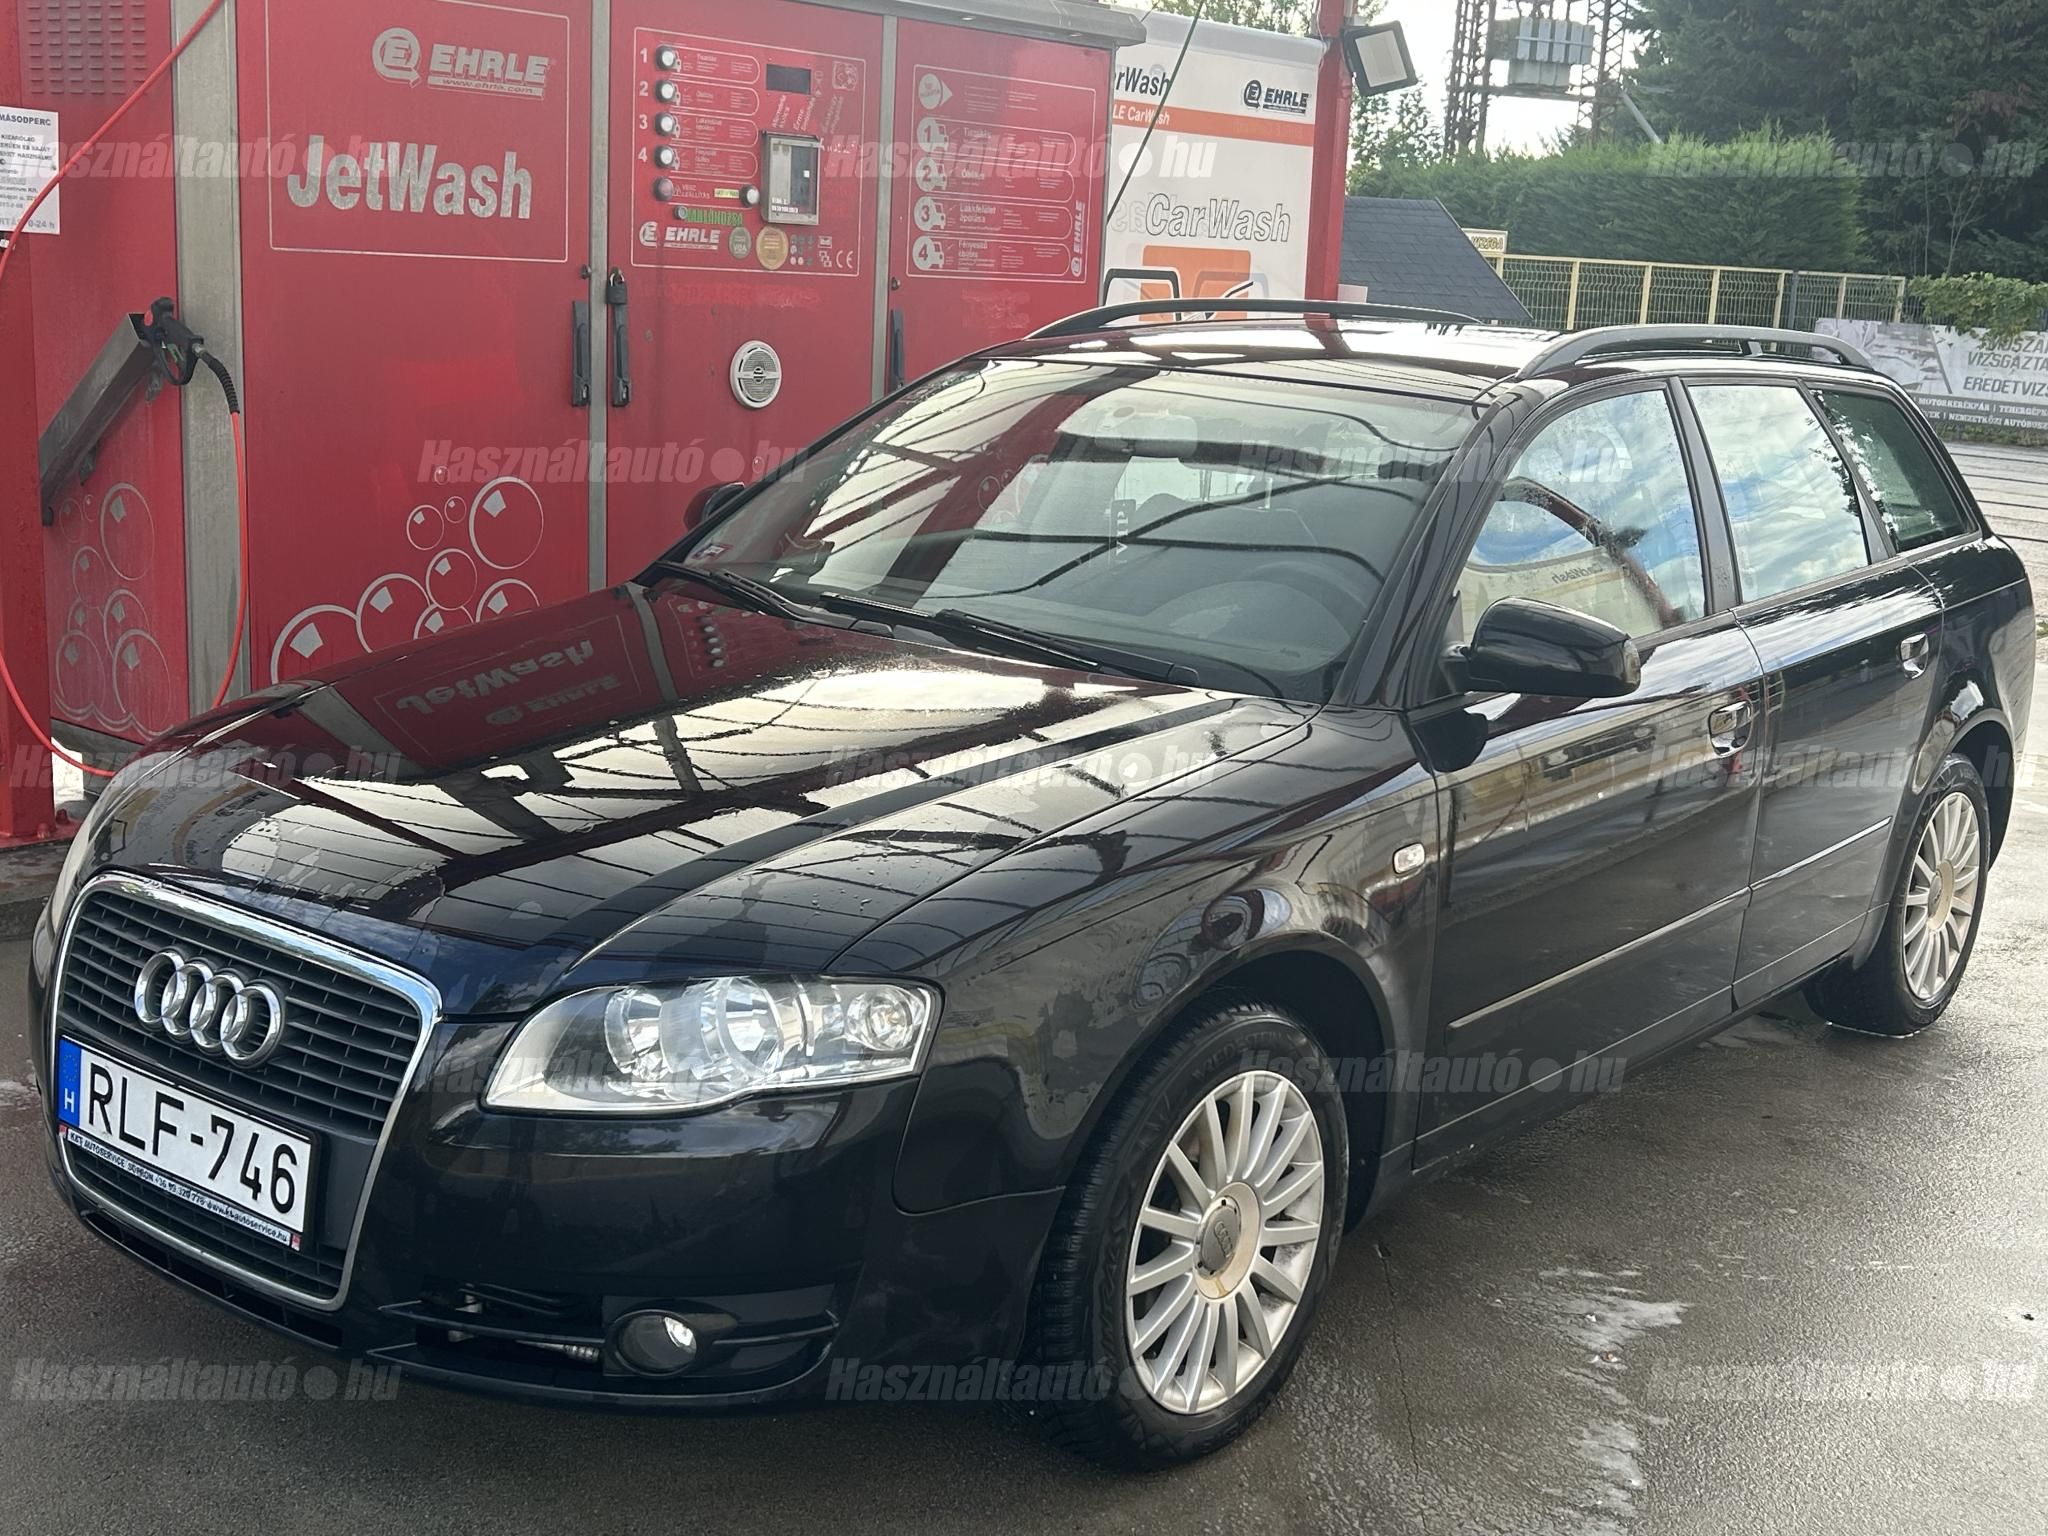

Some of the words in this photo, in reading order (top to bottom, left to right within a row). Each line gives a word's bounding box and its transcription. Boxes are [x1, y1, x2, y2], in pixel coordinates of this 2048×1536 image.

[429, 43, 548, 84] EHRLE
[640, 48, 648, 63] 1
[640, 81, 648, 96] 2
[1114, 66, 1170, 97] rWash
[1264, 87, 1309, 108] EHRLE
[639, 114, 648, 129] 3
[924, 125, 933, 143] 1
[638, 147, 648, 162] 4
[287, 134, 532, 220] JetWash
[922, 165, 932, 182] 2
[920, 205, 930, 222] 3
[1146, 193, 1291, 242] CarWash
[665, 226, 720, 244] EHRLE
[918, 244, 928, 261] 4
[64, 1088, 75, 1113] H
[88, 1062, 298, 1214] RLF-746
